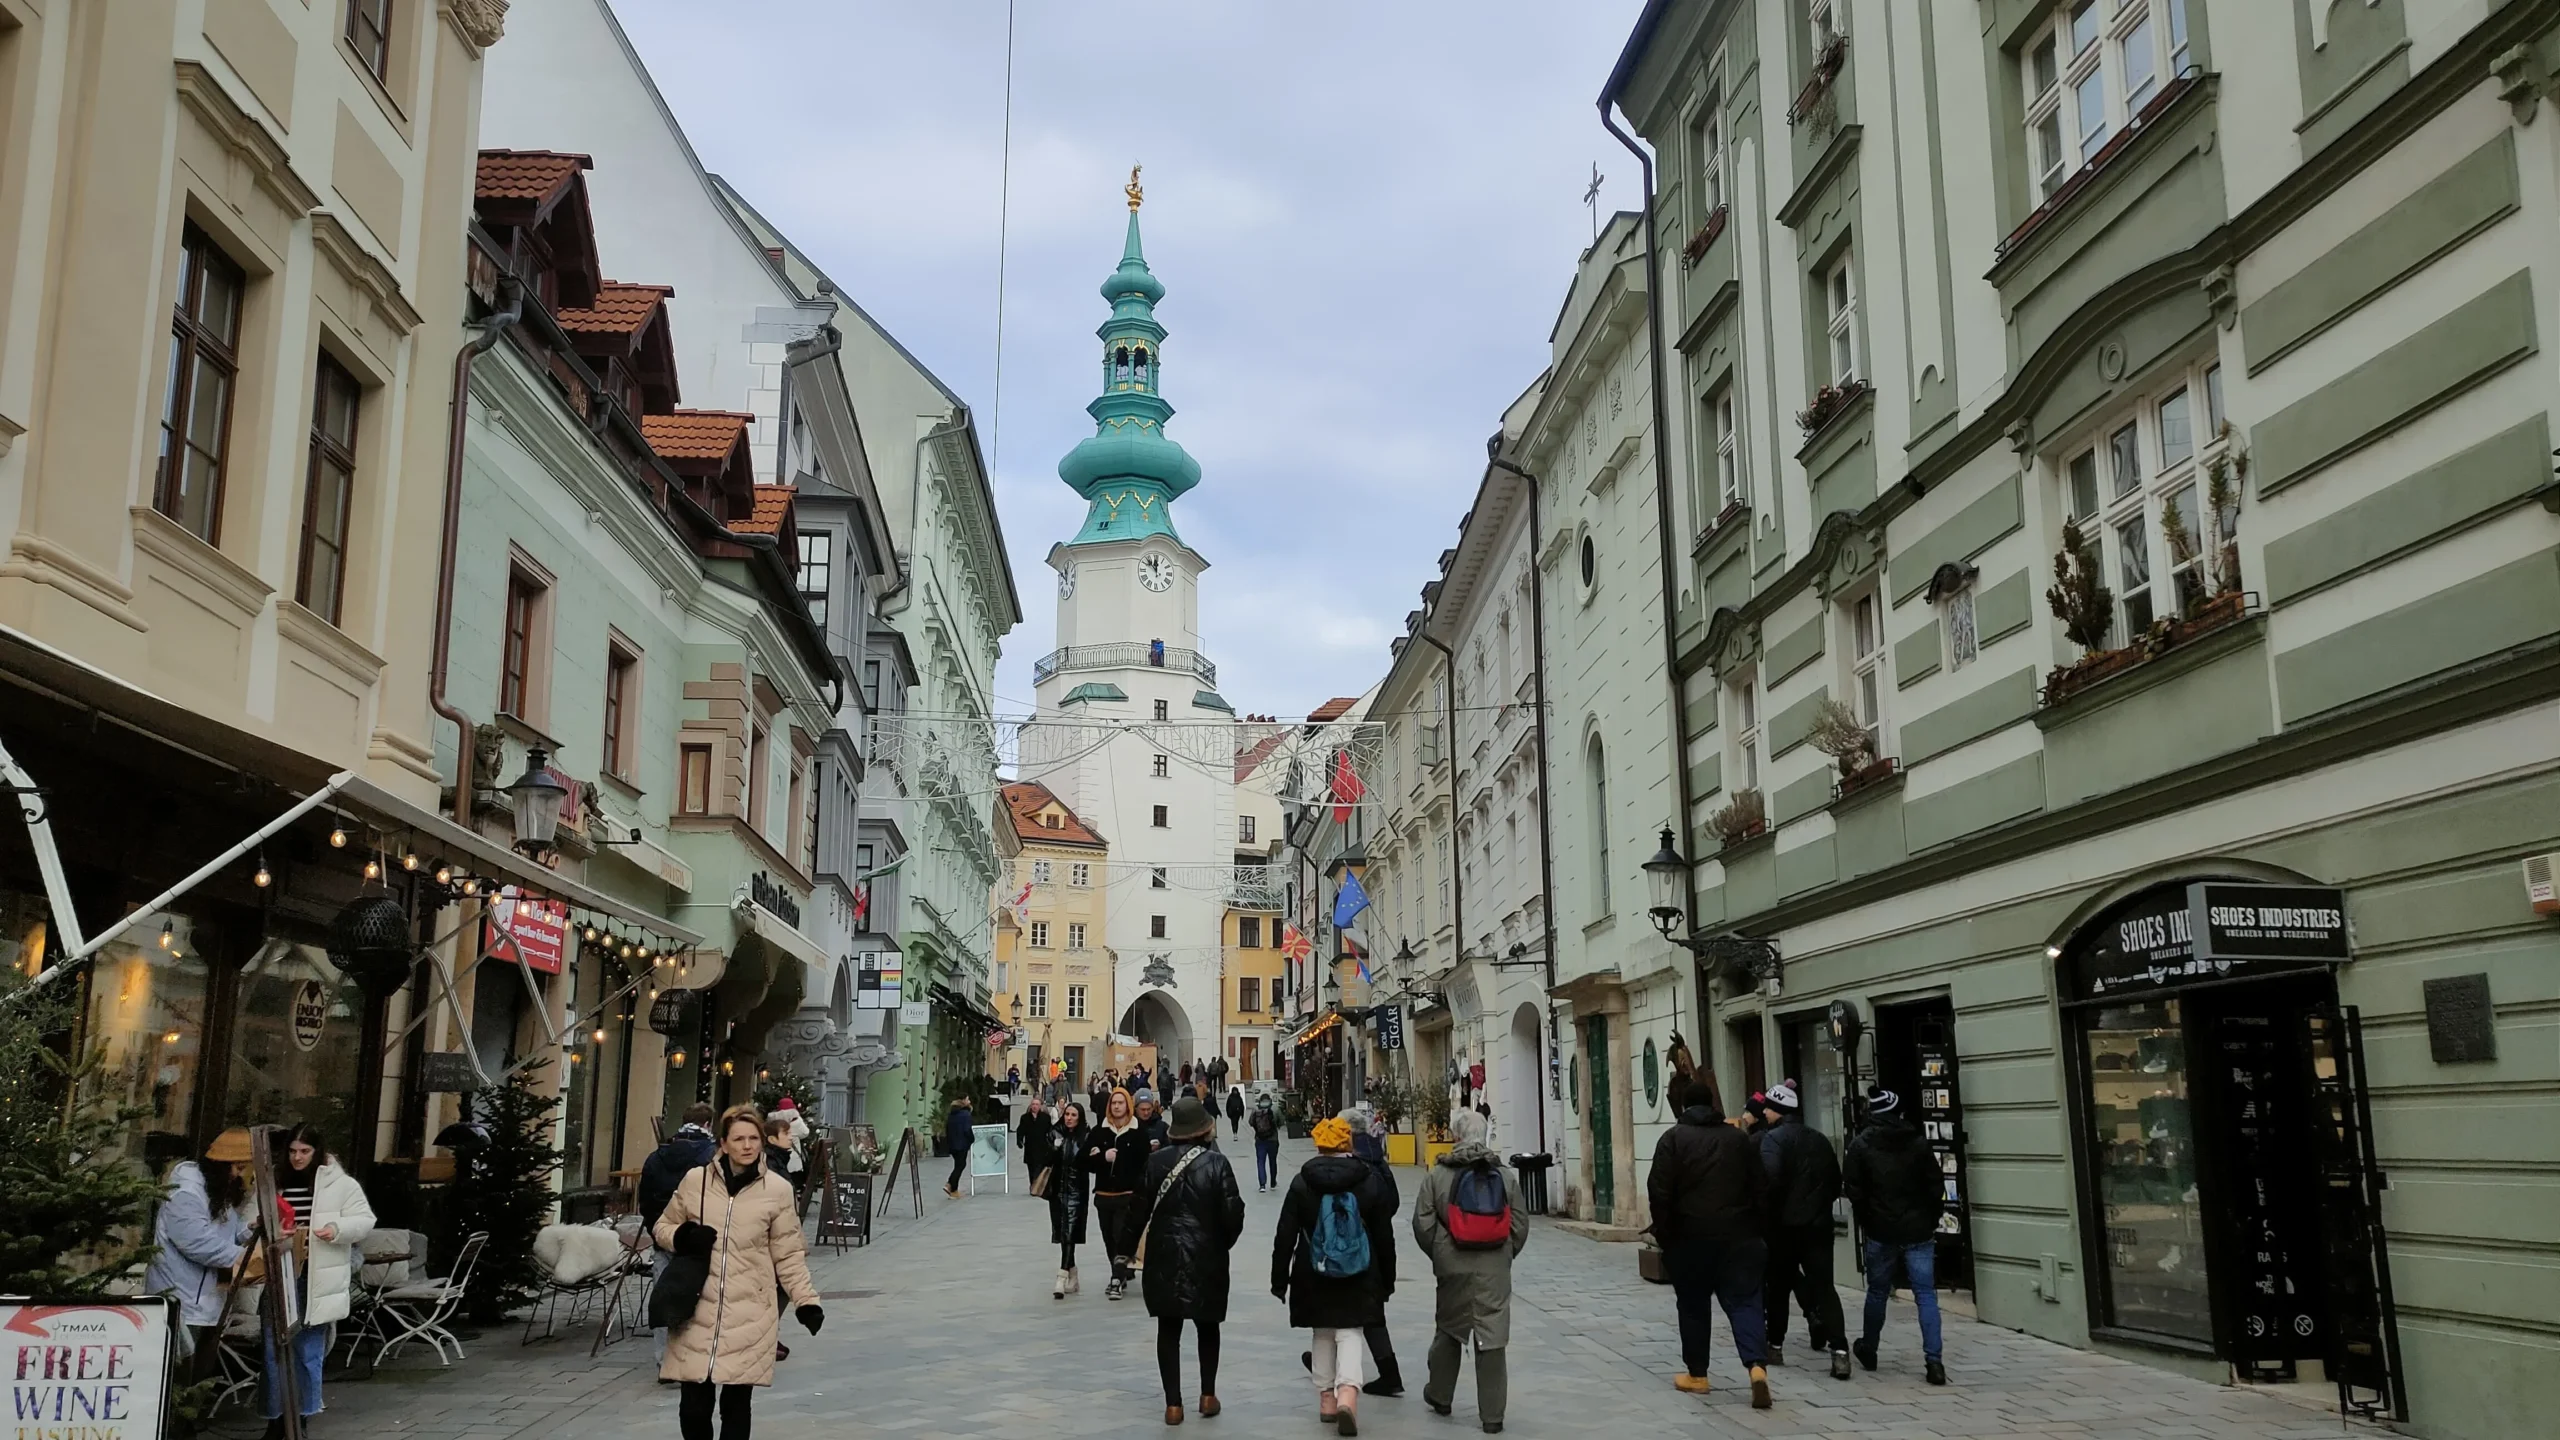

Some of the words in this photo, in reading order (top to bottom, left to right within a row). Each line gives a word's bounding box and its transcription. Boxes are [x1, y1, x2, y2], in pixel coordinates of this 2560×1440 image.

[2210, 906, 2256, 927] SHOES
[2258, 907, 2341, 929] INDUSTRIES
[2120, 914, 2166, 953] SHOES
[2225, 929, 2263, 938] SNEAKERS
[2264, 930, 2280, 938] AND
[2282, 930, 2329, 939] STREETWEAR
[296, 1003, 325, 1018] ENJOY
[906, 1008, 925, 1017] Dior
[1386, 1006, 1401, 1049] CIGÁR
[61, 1322, 107, 1333] TMAVÁ
[12, 1344, 134, 1381] FREE
[12, 1385, 130, 1422] WINE
